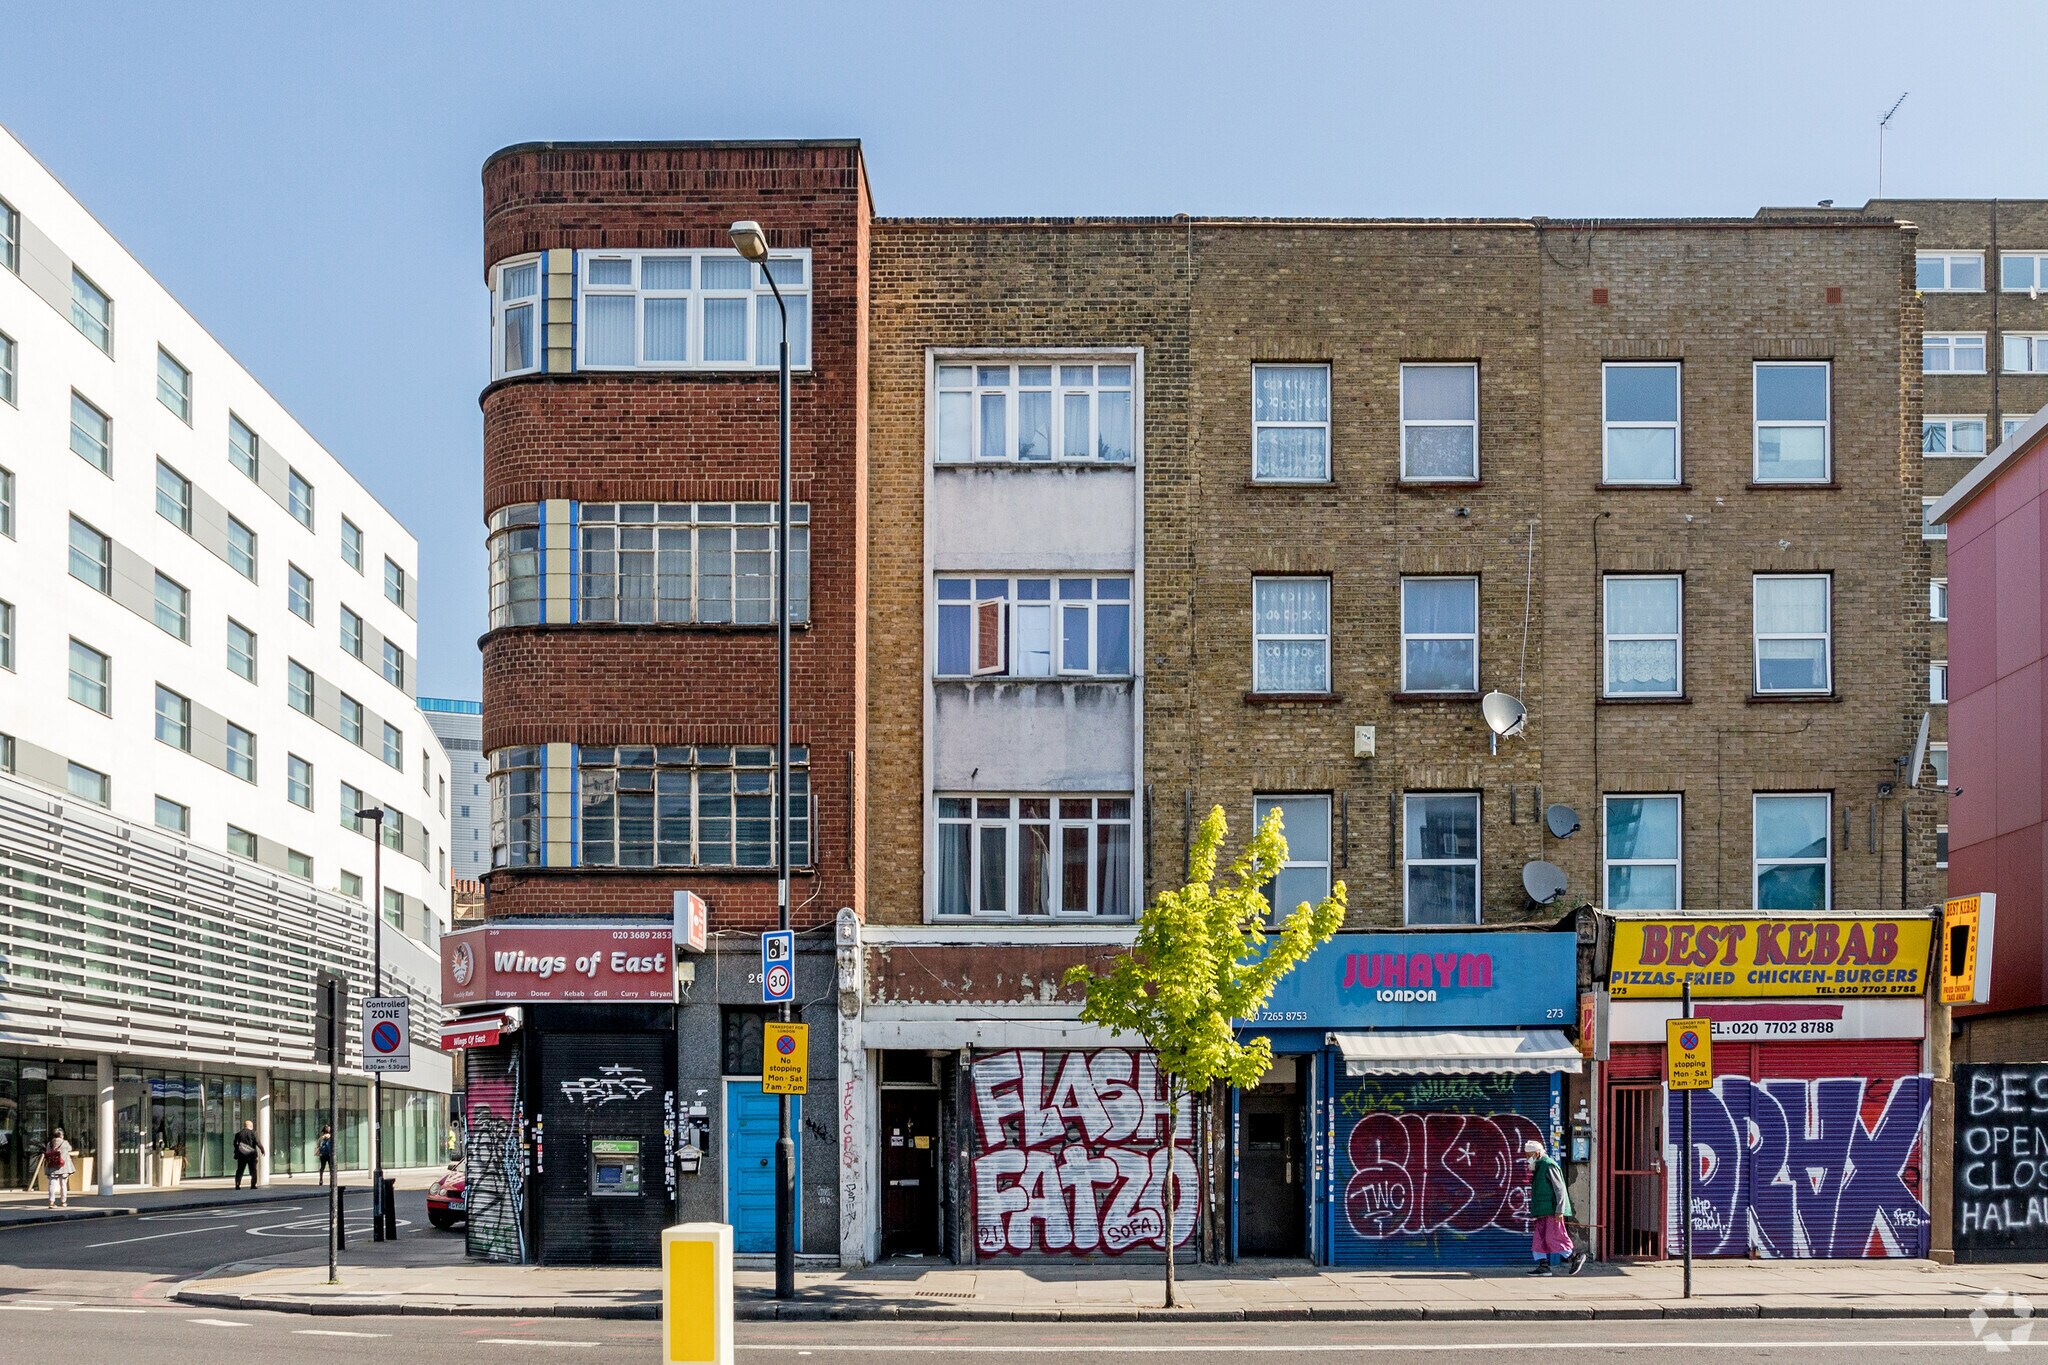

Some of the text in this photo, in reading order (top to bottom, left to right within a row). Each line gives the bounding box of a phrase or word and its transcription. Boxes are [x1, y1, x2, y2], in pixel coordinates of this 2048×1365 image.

[1946, 899, 1977, 917] BEST KEBAB
[612, 931, 672, 939] 020 3689 2853
[1639, 923, 1899, 967] BEST KEBAB
[1968, 916, 1976, 981] BURGERS
[494, 950, 666, 979] Wings of East
[1342, 953, 1493, 988] JUHAYM
[770, 975, 787, 987] 30
[1611, 987, 1627, 995] 275
[1815, 985, 1917, 994] TEL: 020 7702 8788
[1954, 984, 1970, 993] CHICKEN
[495, 990, 517, 998] Burger
[620, 990, 639, 998] Curry
[650, 990, 673, 998] Biryani
[1376, 989, 1437, 1002] LONDON
[365, 1000, 406, 1008] Controlled
[371, 1010, 400, 1019] ZONE
[1262, 1012, 1283, 1021] 7265
[1286, 1011, 1308, 1021] 8753
[1546, 1008, 1564, 1018] 273
[1711, 1021, 1834, 1034] EL: 020 7702 8788
[453, 1036, 467, 1047] Wings
[474, 1034, 486, 1043] East
[769, 1065, 802, 1073] stopping
[1674, 1060, 1706, 1068] stopping
[971, 1047, 1195, 1149] FLASH
